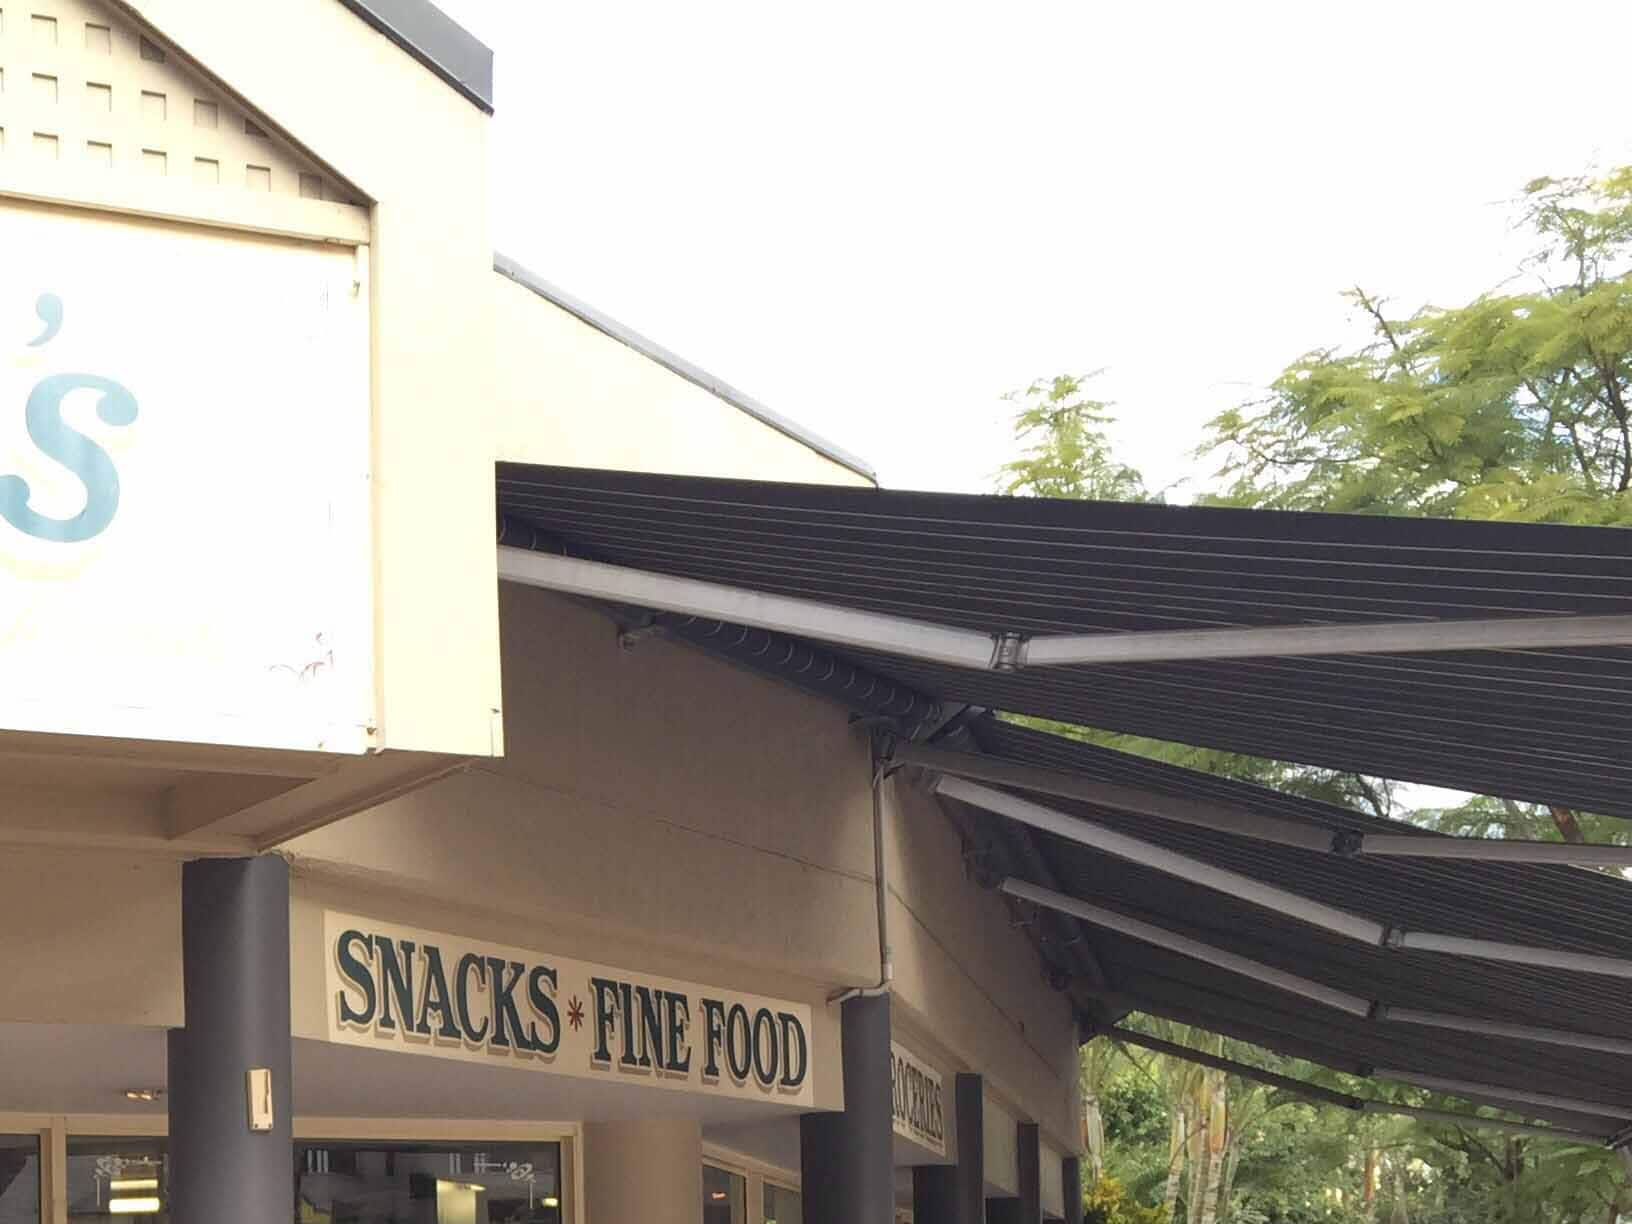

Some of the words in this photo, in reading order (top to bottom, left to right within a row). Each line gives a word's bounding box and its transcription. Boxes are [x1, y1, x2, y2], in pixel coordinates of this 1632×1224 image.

[335, 929, 561, 1058] SNACKS
[590, 977, 693, 1076] FINE
[703, 1000, 808, 1090] FOOD
